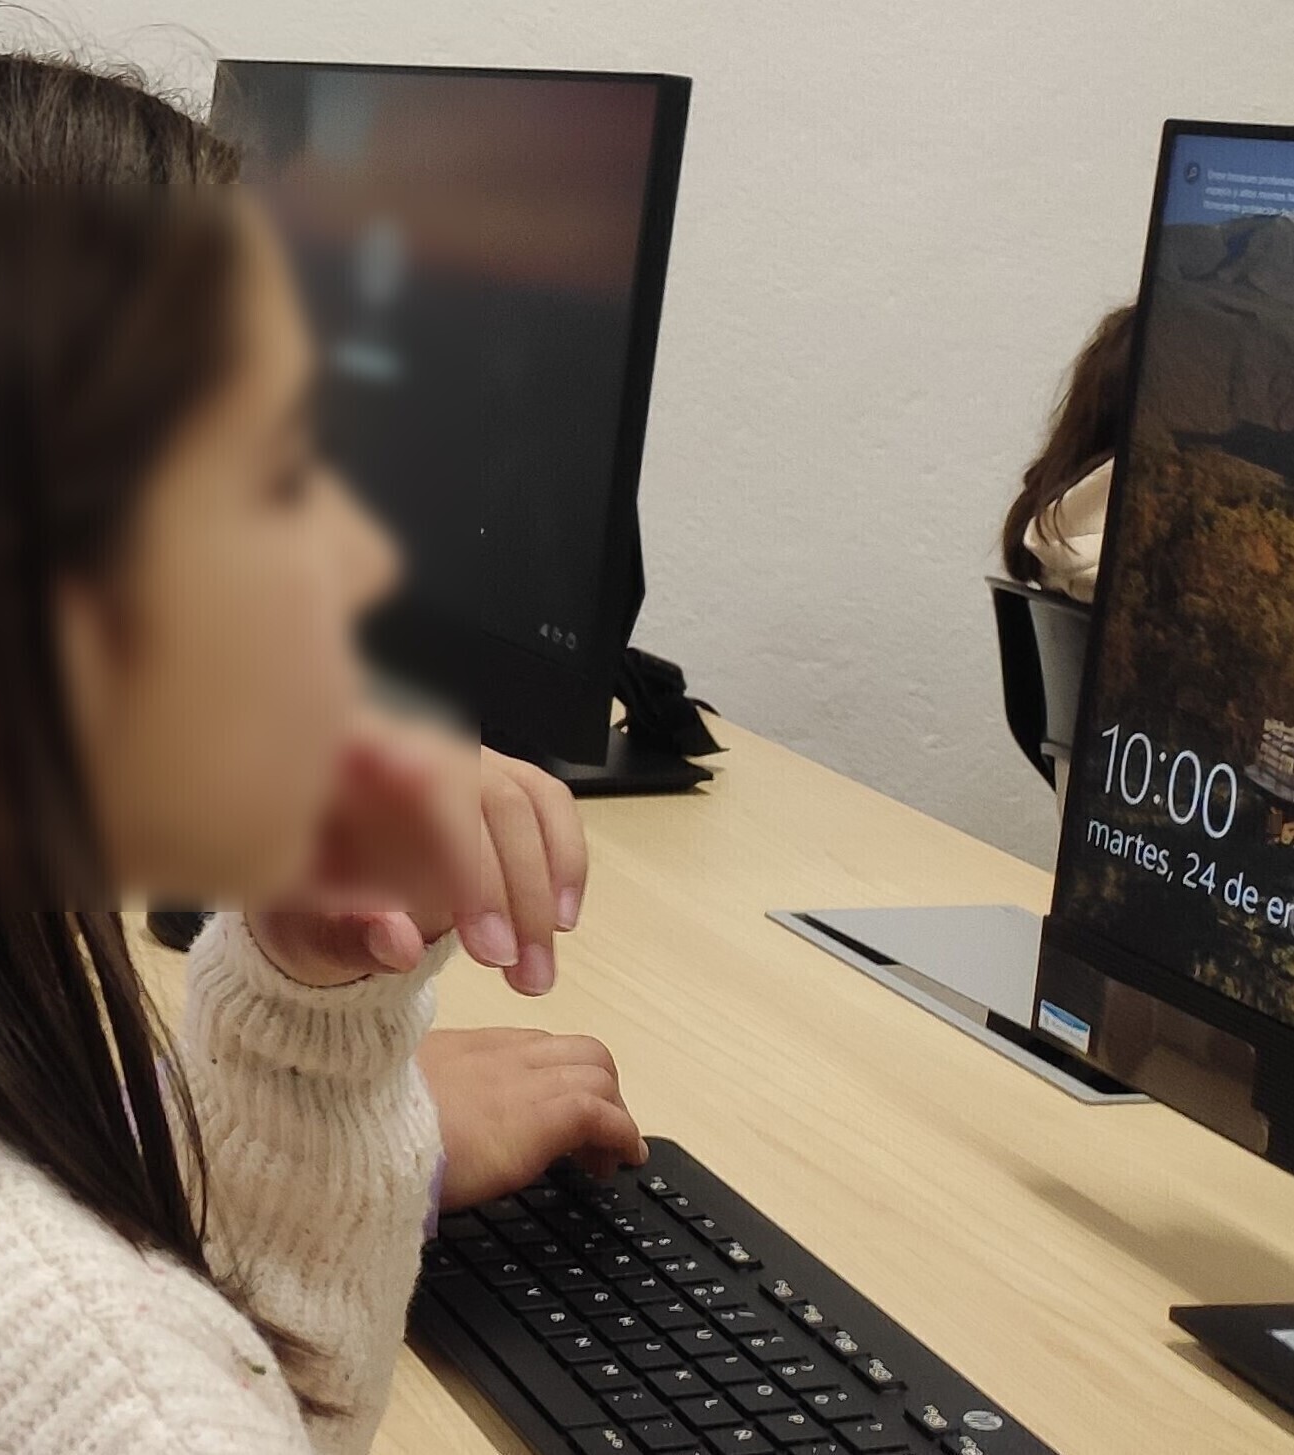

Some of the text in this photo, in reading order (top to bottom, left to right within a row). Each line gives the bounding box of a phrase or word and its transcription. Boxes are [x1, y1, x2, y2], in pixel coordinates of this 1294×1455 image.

[1102, 724, 1237, 839] 10:00
[1087, 818, 1174, 882] martes,
[1182, 852, 1216, 895] 24
[1223, 872, 1259, 914] de
